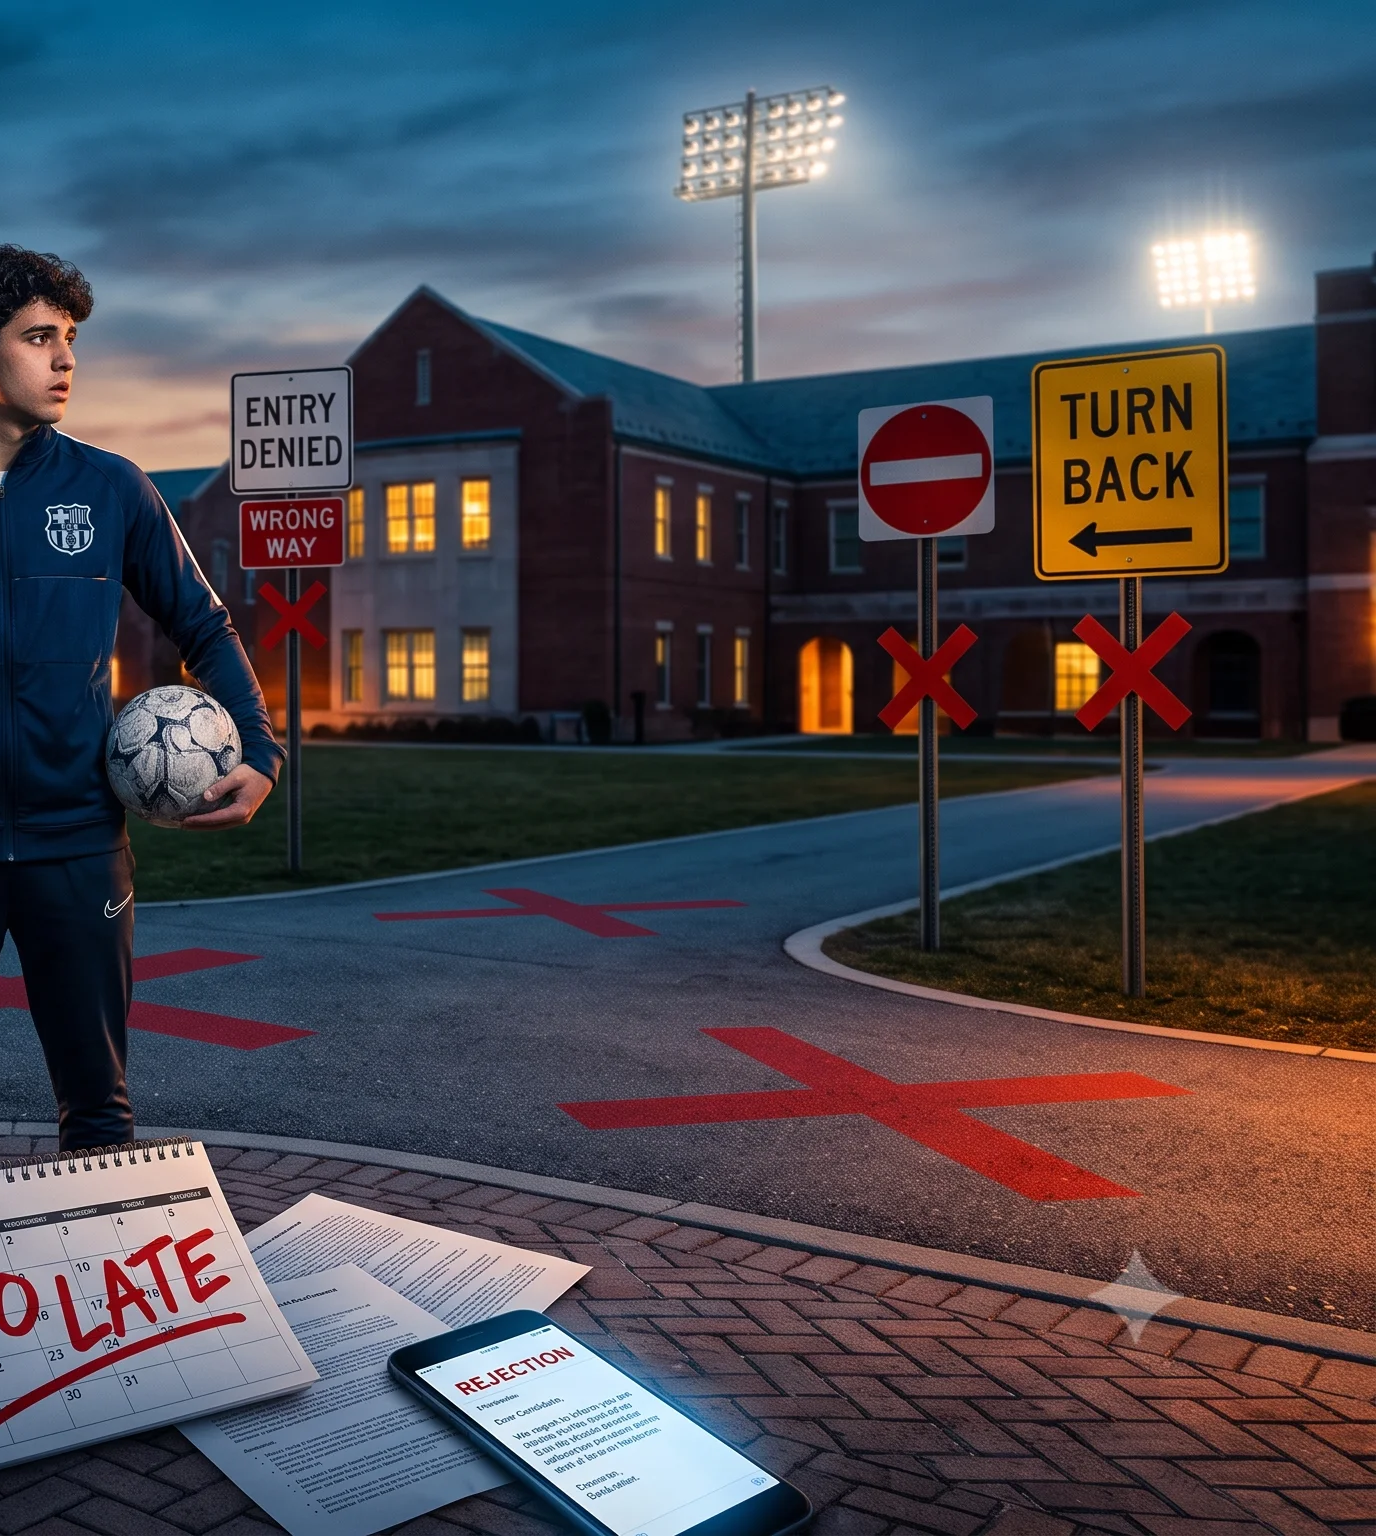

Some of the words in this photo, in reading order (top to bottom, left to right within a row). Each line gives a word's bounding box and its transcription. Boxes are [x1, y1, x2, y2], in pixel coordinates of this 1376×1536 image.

[246, 392, 336, 428] ENTRY
[1060, 382, 1193, 440] TURN
[240, 435, 343, 470] DENIED
[1063, 450, 1195, 505] BACK
[249, 507, 335, 531] WRONG
[266, 536, 317, 559] WAY
[5, 1236, 14, 1245] 2
[62, 1226, 69, 1236] 3
[116, 1217, 124, 1226] 4
[168, 1208, 175, 1217] 5
[75, 1261, 91, 1274] 10
[54, 1228, 231, 1352] LATE
[90, 1298, 103, 1311] 17
[48, 1348, 65, 1362] 23
[104, 1337, 120, 1350] 24
[64, 1388, 82, 1401] 30
[123, 1374, 139, 1387] 31
[454, 1346, 575, 1396] REJECTION
